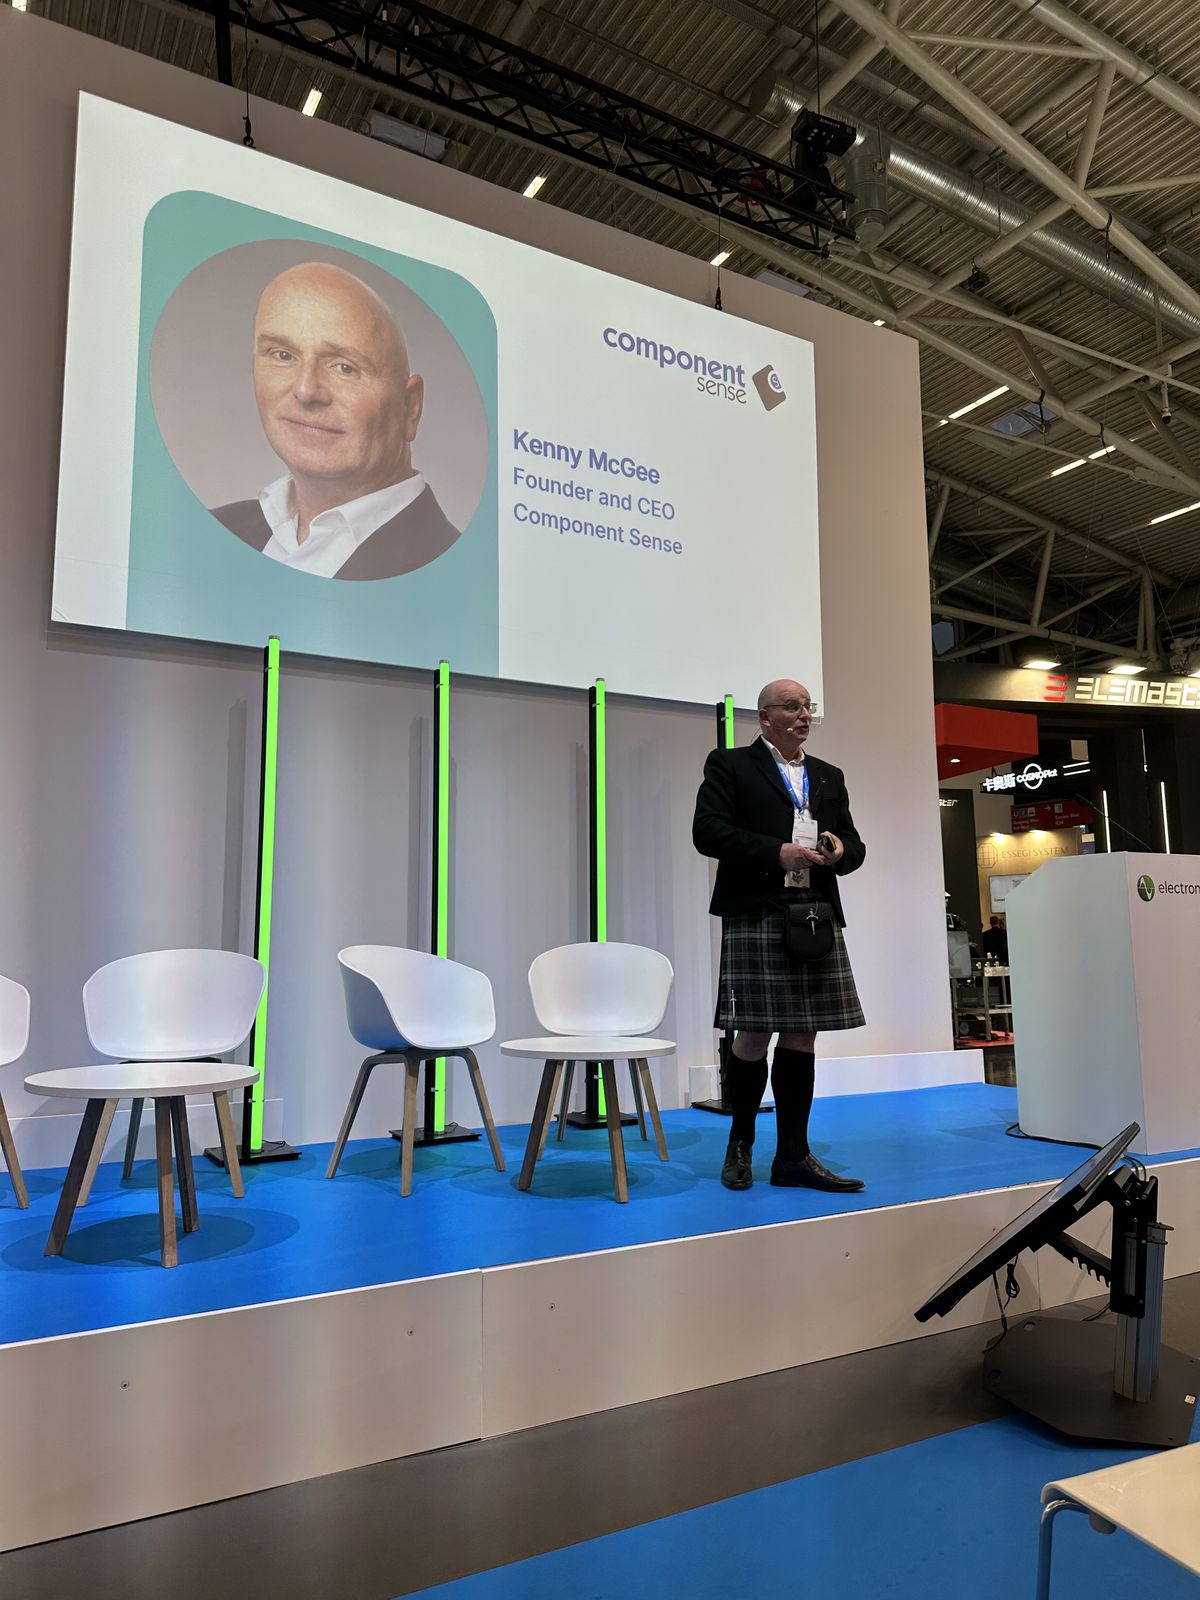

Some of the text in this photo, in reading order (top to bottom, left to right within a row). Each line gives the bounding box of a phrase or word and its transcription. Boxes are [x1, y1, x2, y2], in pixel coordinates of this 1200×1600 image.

[603, 327, 746, 388] component
[696, 376, 747, 404] sense
[513, 429, 660, 485] Kenny McGee
[513, 467, 675, 520] Founder and CEO
[513, 503, 683, 555] Component Sense
[1001, 847, 1069, 858] ESSEGI SYSTEM
